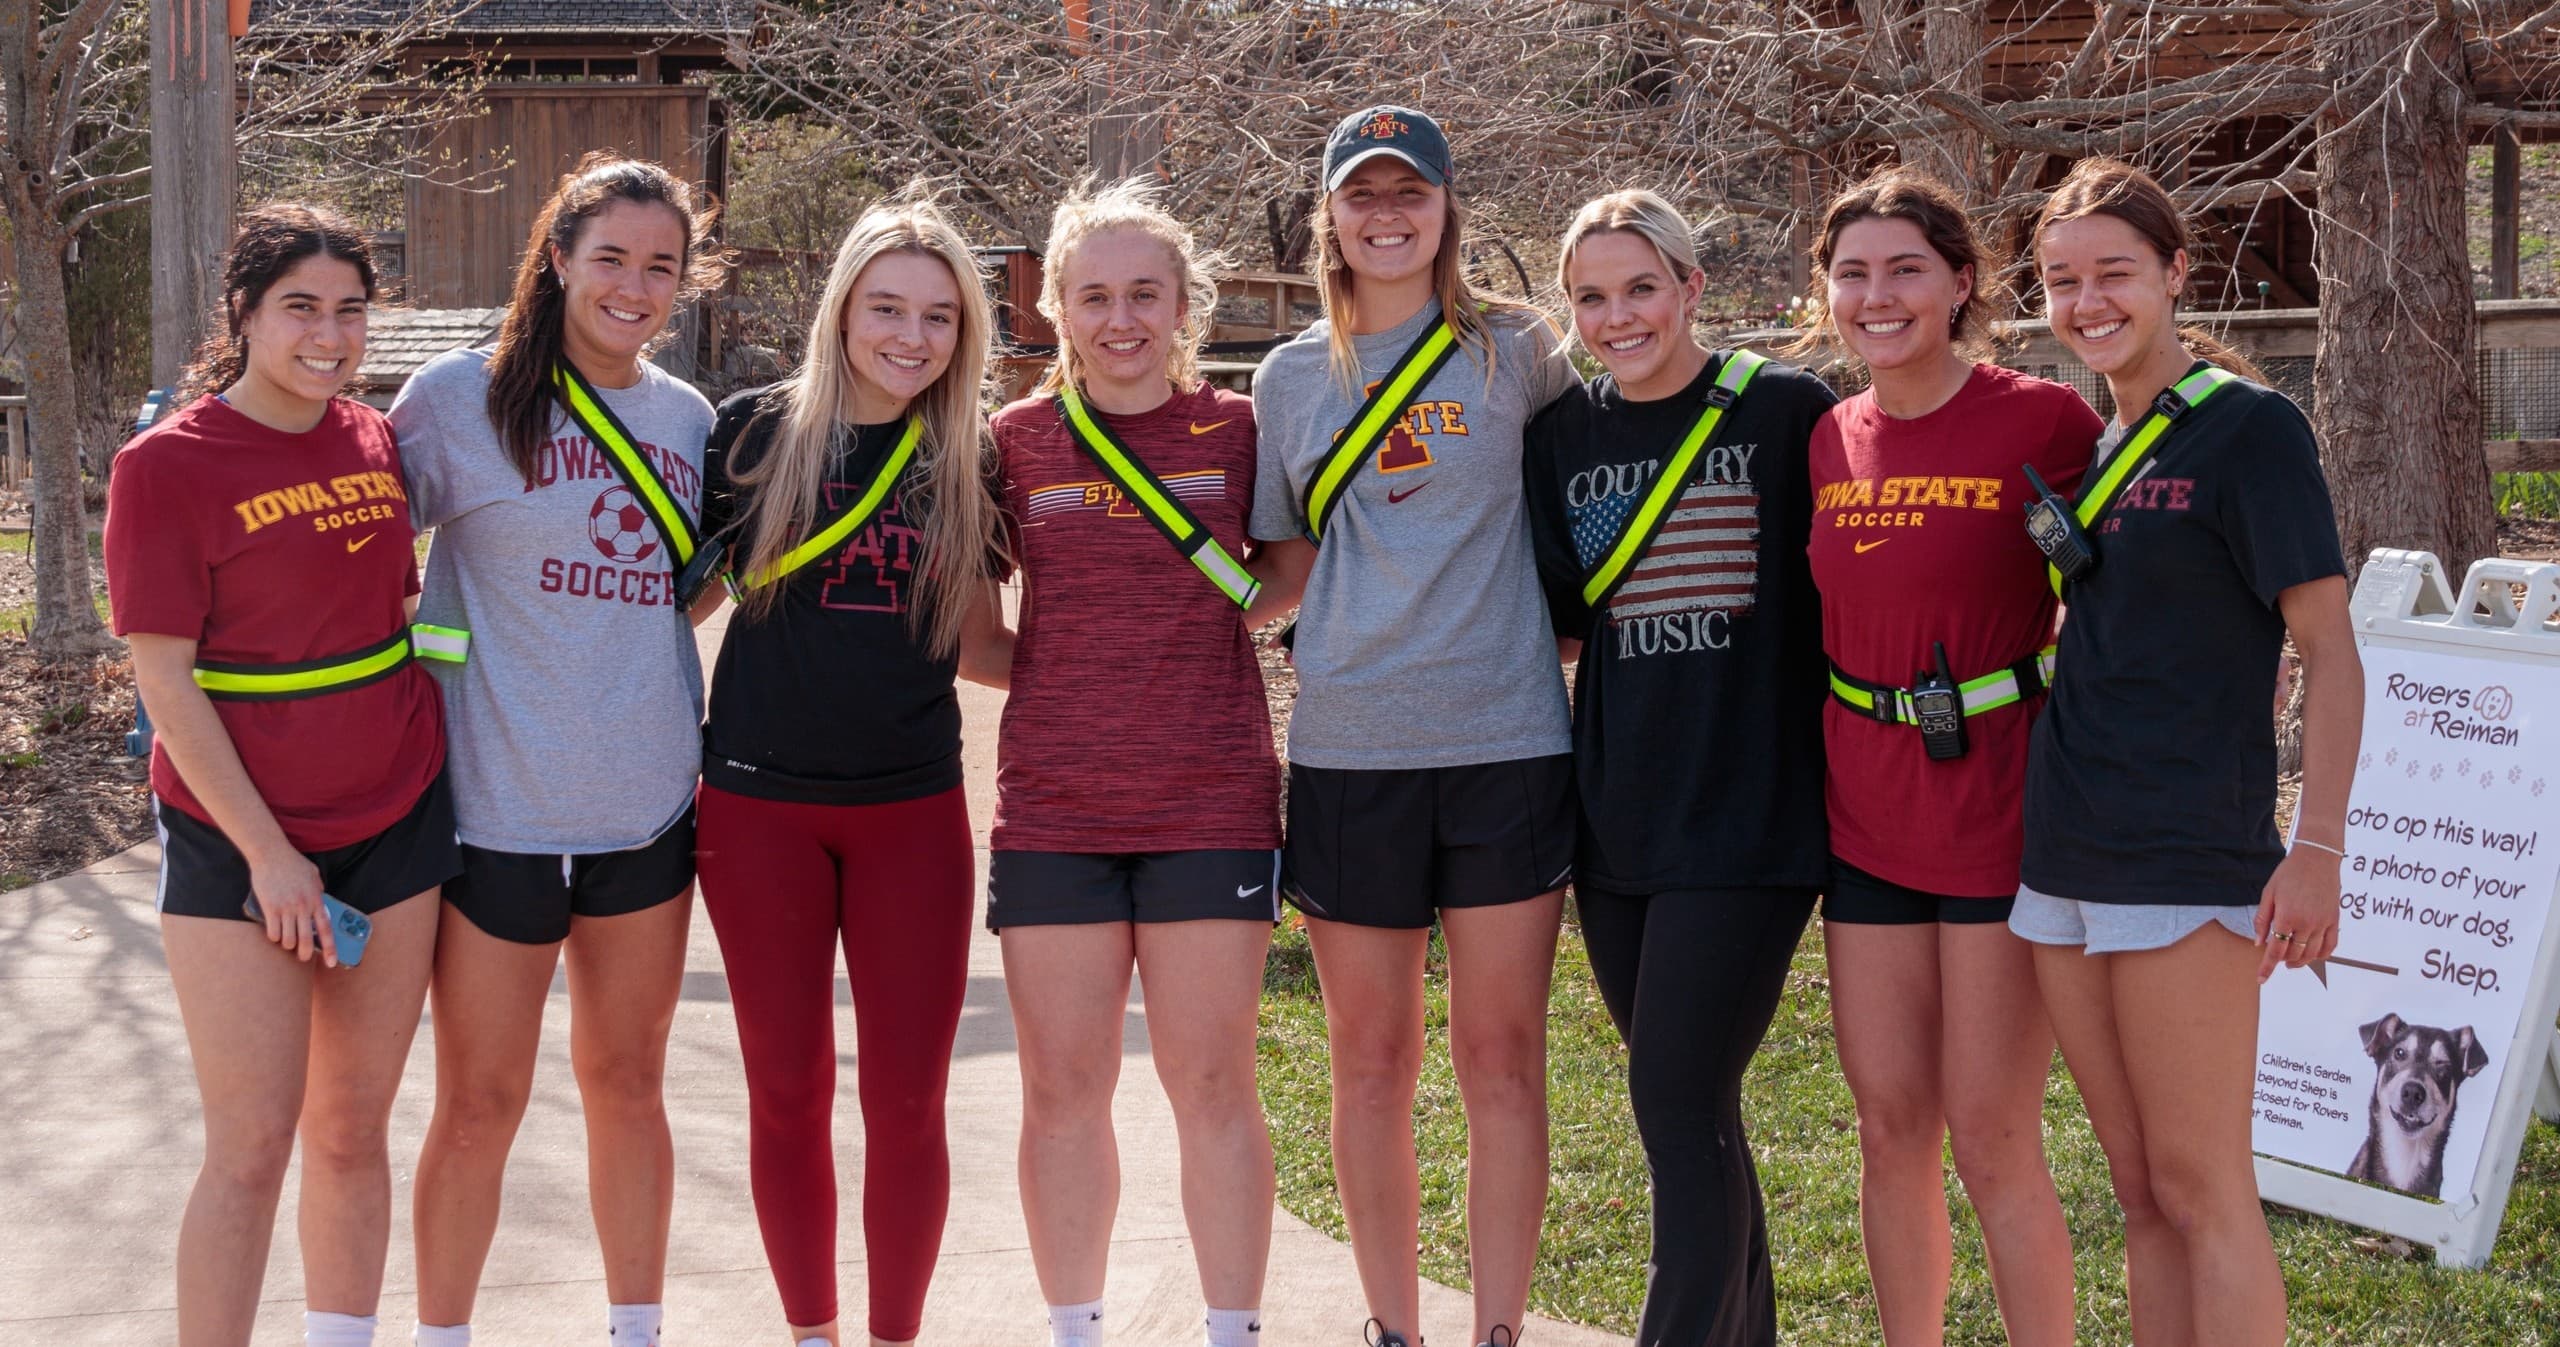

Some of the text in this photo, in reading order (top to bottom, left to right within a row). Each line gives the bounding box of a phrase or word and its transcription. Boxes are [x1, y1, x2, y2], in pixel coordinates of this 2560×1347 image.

[1360, 120, 1409, 137] STATE
[524, 435, 613, 493] OWA
[1567, 443, 1758, 508] COURY
[234, 470, 408, 534] IOWA STAT
[1877, 476, 2003, 511] STATE
[2112, 478, 2195, 511] ATE
[313, 504, 395, 532] SOCCER
[1834, 512, 1925, 528] SOCCER
[2386, 673, 2471, 708] Rovers
[2403, 707, 2519, 747] at Reiman
[2347, 806, 2537, 860] oto op this way!
[2352, 854, 2526, 899] a photo of your
[2340, 892, 2514, 948] og with our dog,
[2421, 948, 2500, 997] Shep.
[2257, 1070, 2338, 1100] beyond Shep is
[2261, 1053, 2352, 1085] Children's Garden
[2263, 1109, 2304, 1130] Reiman.
[2293, 1096, 2311, 1111] for
[2312, 1101, 2349, 1122] Rovers
